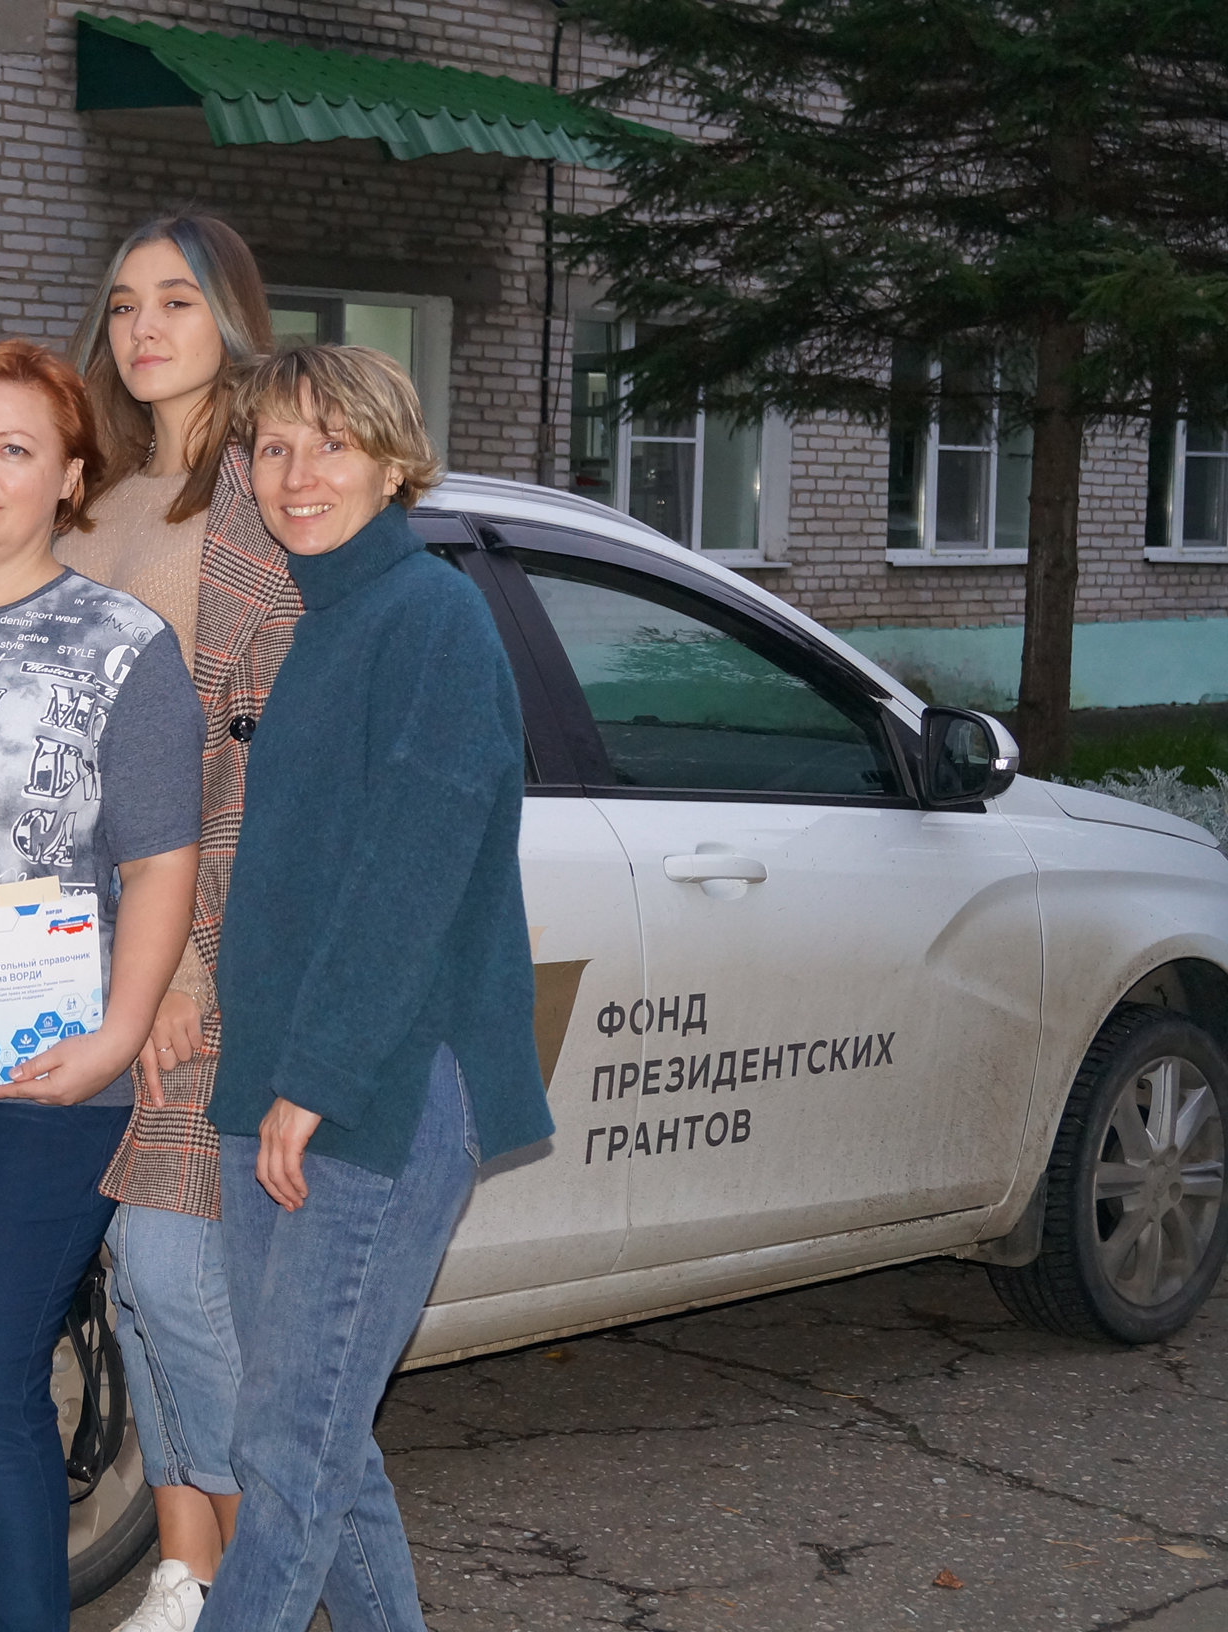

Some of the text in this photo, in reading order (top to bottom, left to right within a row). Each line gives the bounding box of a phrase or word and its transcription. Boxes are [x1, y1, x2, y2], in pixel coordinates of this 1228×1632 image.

[0, 615, 33, 627] denim
[25, 610, 83, 625] sport wear
[0, 641, 25, 651] style
[17, 633, 49, 644] active
[57, 645, 97, 659] STYLE
[26, 663, 75, 678] Masters
[39, 952, 91, 967] справочник
[9, 970, 43, 982] ВОРДИ
[596, 993, 708, 1038] ФОНД
[591, 1031, 896, 1102] ПРЕЗИДЕНТСКИХ
[585, 1108, 752, 1164] ГРАНТОВ
